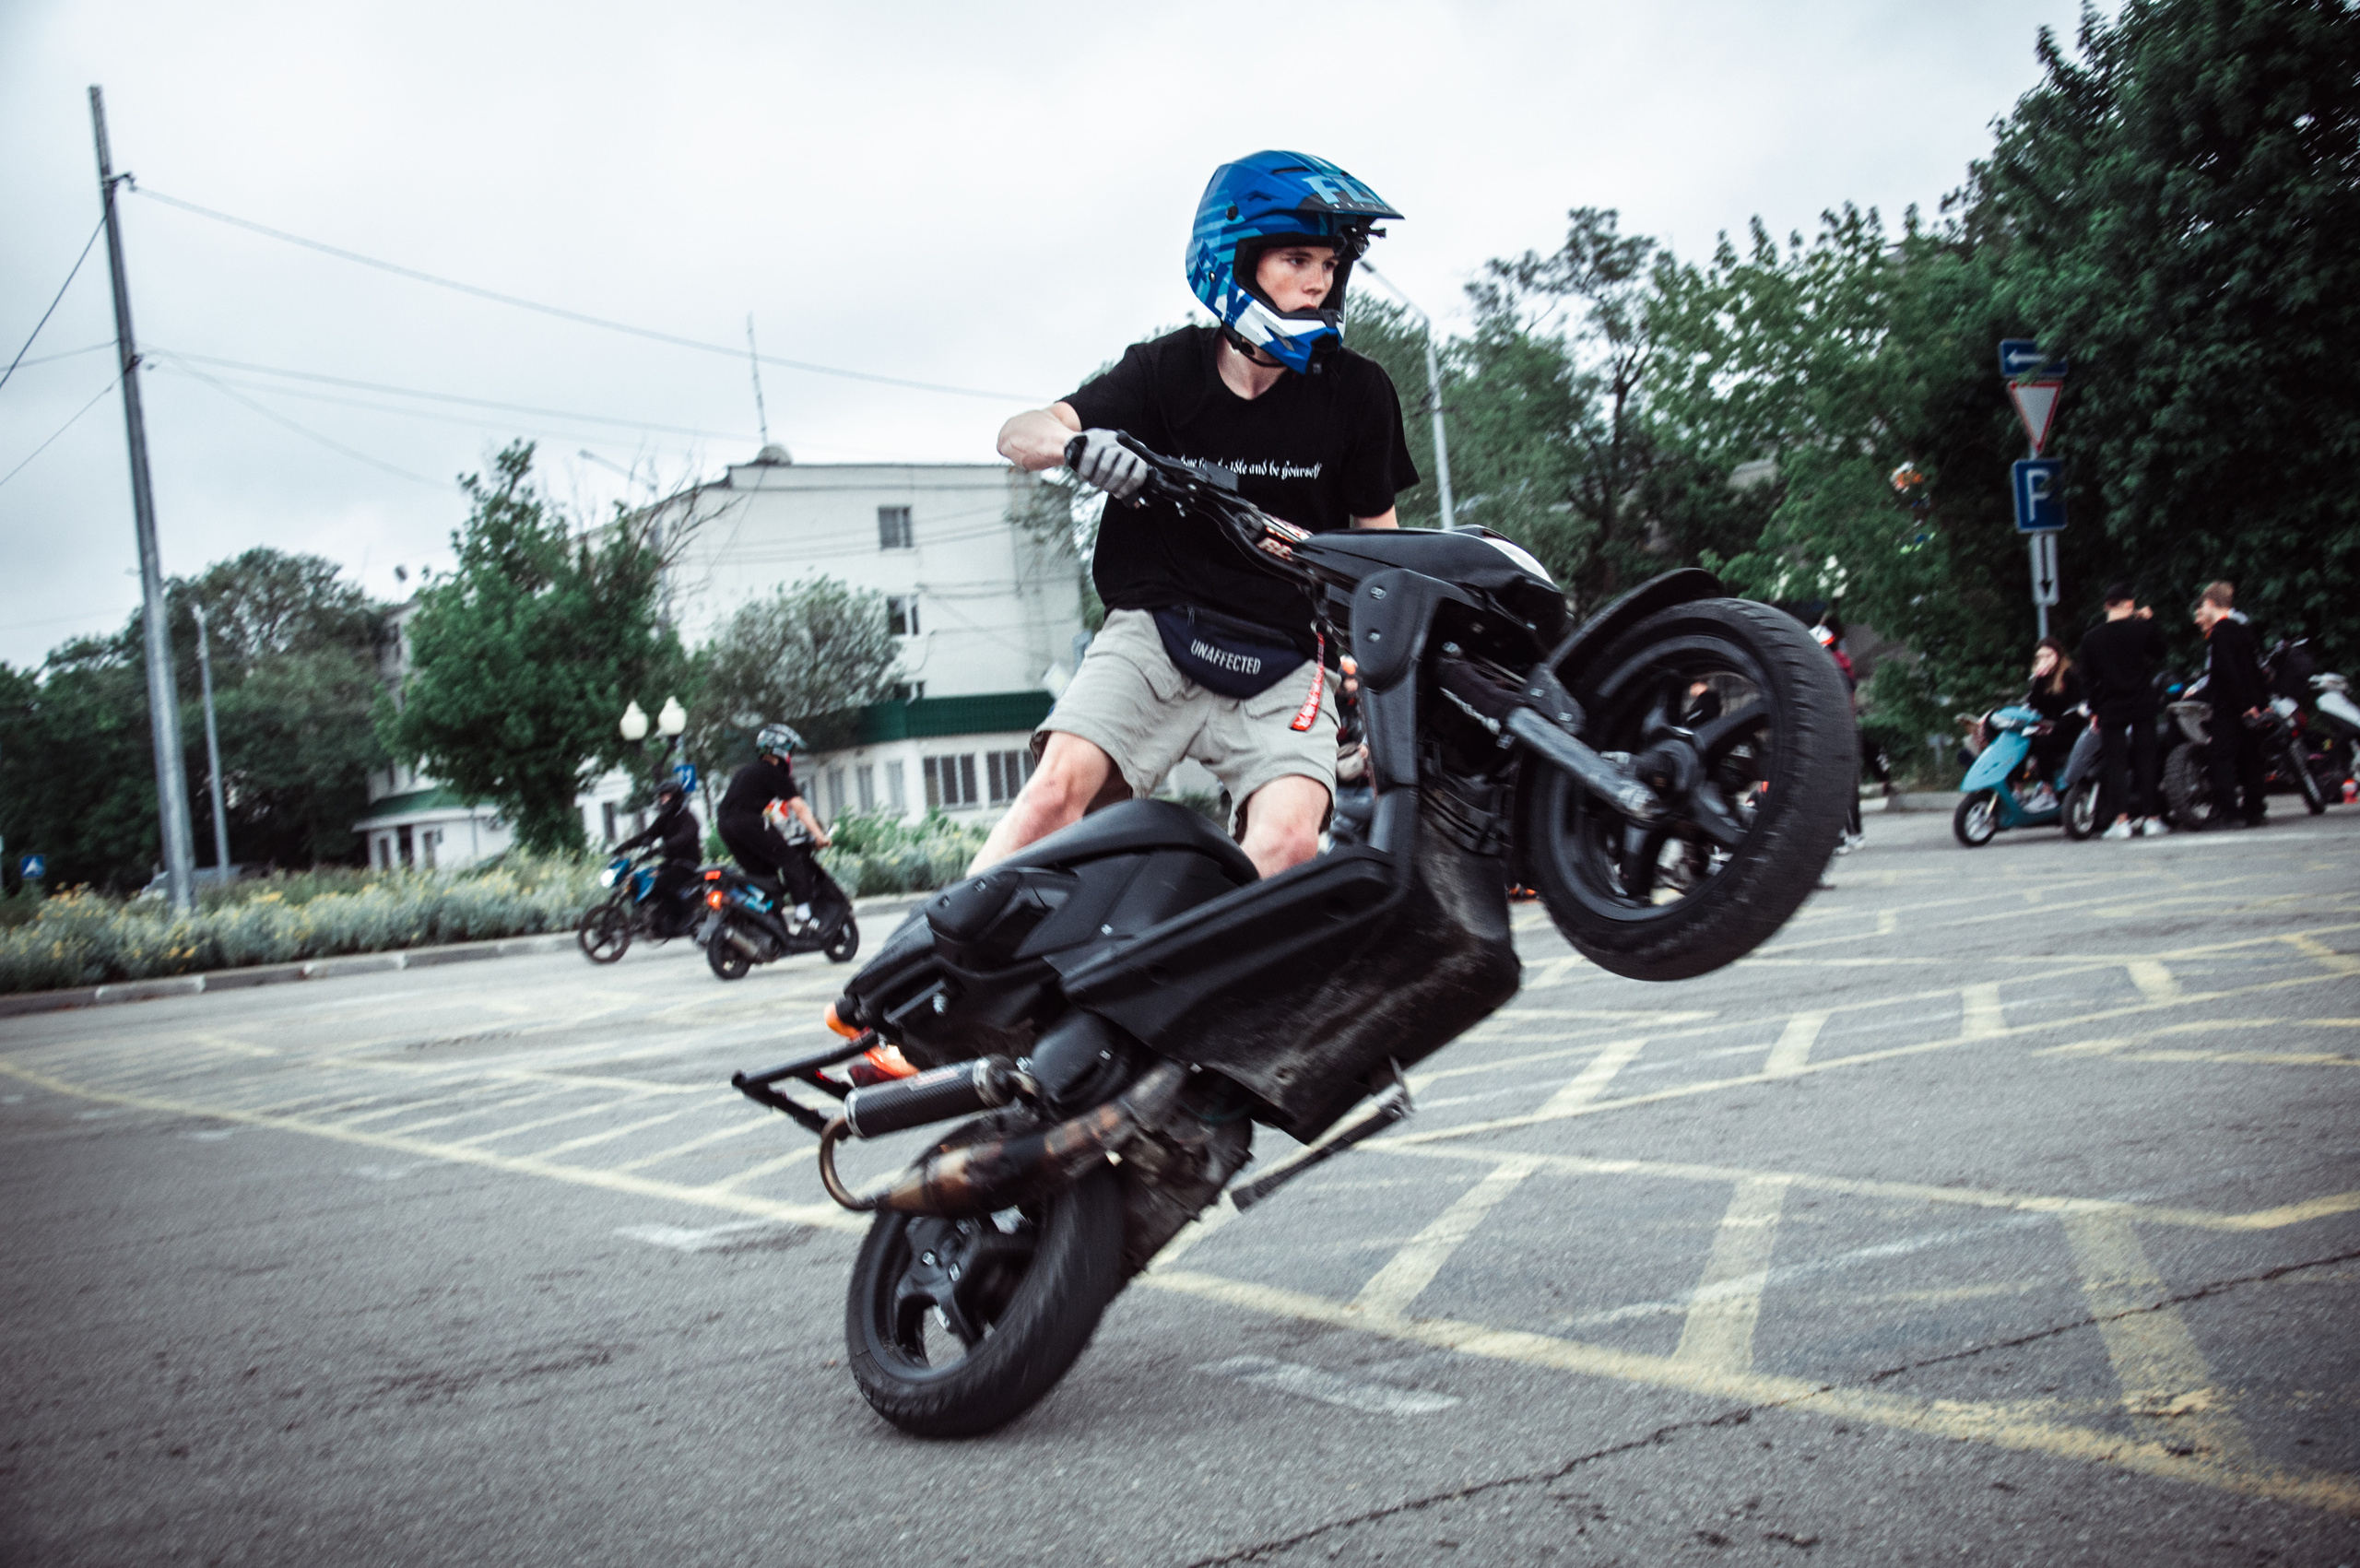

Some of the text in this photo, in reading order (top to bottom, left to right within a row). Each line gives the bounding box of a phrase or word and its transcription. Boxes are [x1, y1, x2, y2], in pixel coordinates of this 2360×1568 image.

[1248, 458, 1268, 476] and
[1268, 458, 1280, 477] be
[1280, 459, 1323, 480] yourself
[1190, 638, 1261, 676] UNAFFECTED
